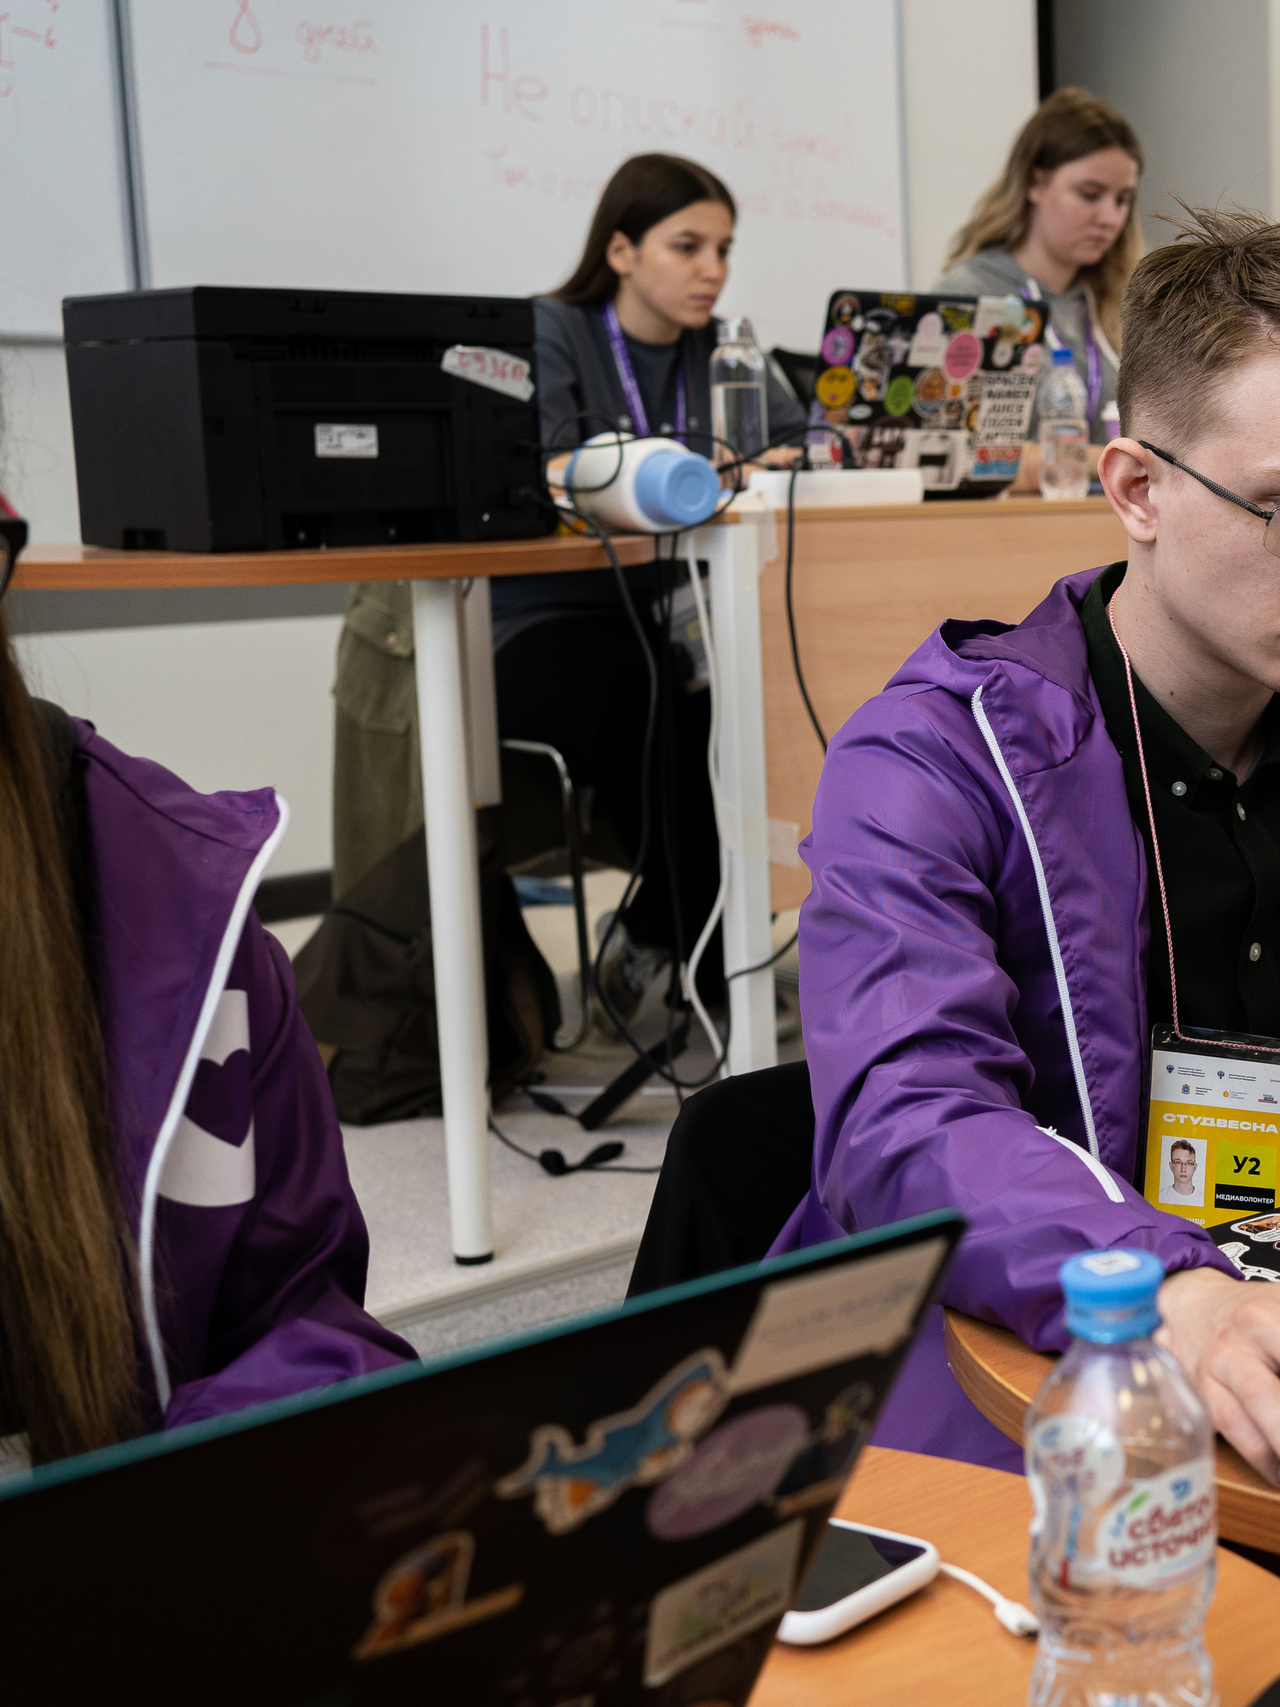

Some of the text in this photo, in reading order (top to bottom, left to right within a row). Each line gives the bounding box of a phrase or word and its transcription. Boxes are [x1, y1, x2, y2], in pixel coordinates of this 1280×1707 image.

[479, 21, 551, 122] Не
[1162, 1112, 1279, 1134] СТУДВЕСНА
[1232, 1154, 1261, 1176] У2
[1215, 1193, 1275, 1205] МЕДИАВОЛОНТЕР
